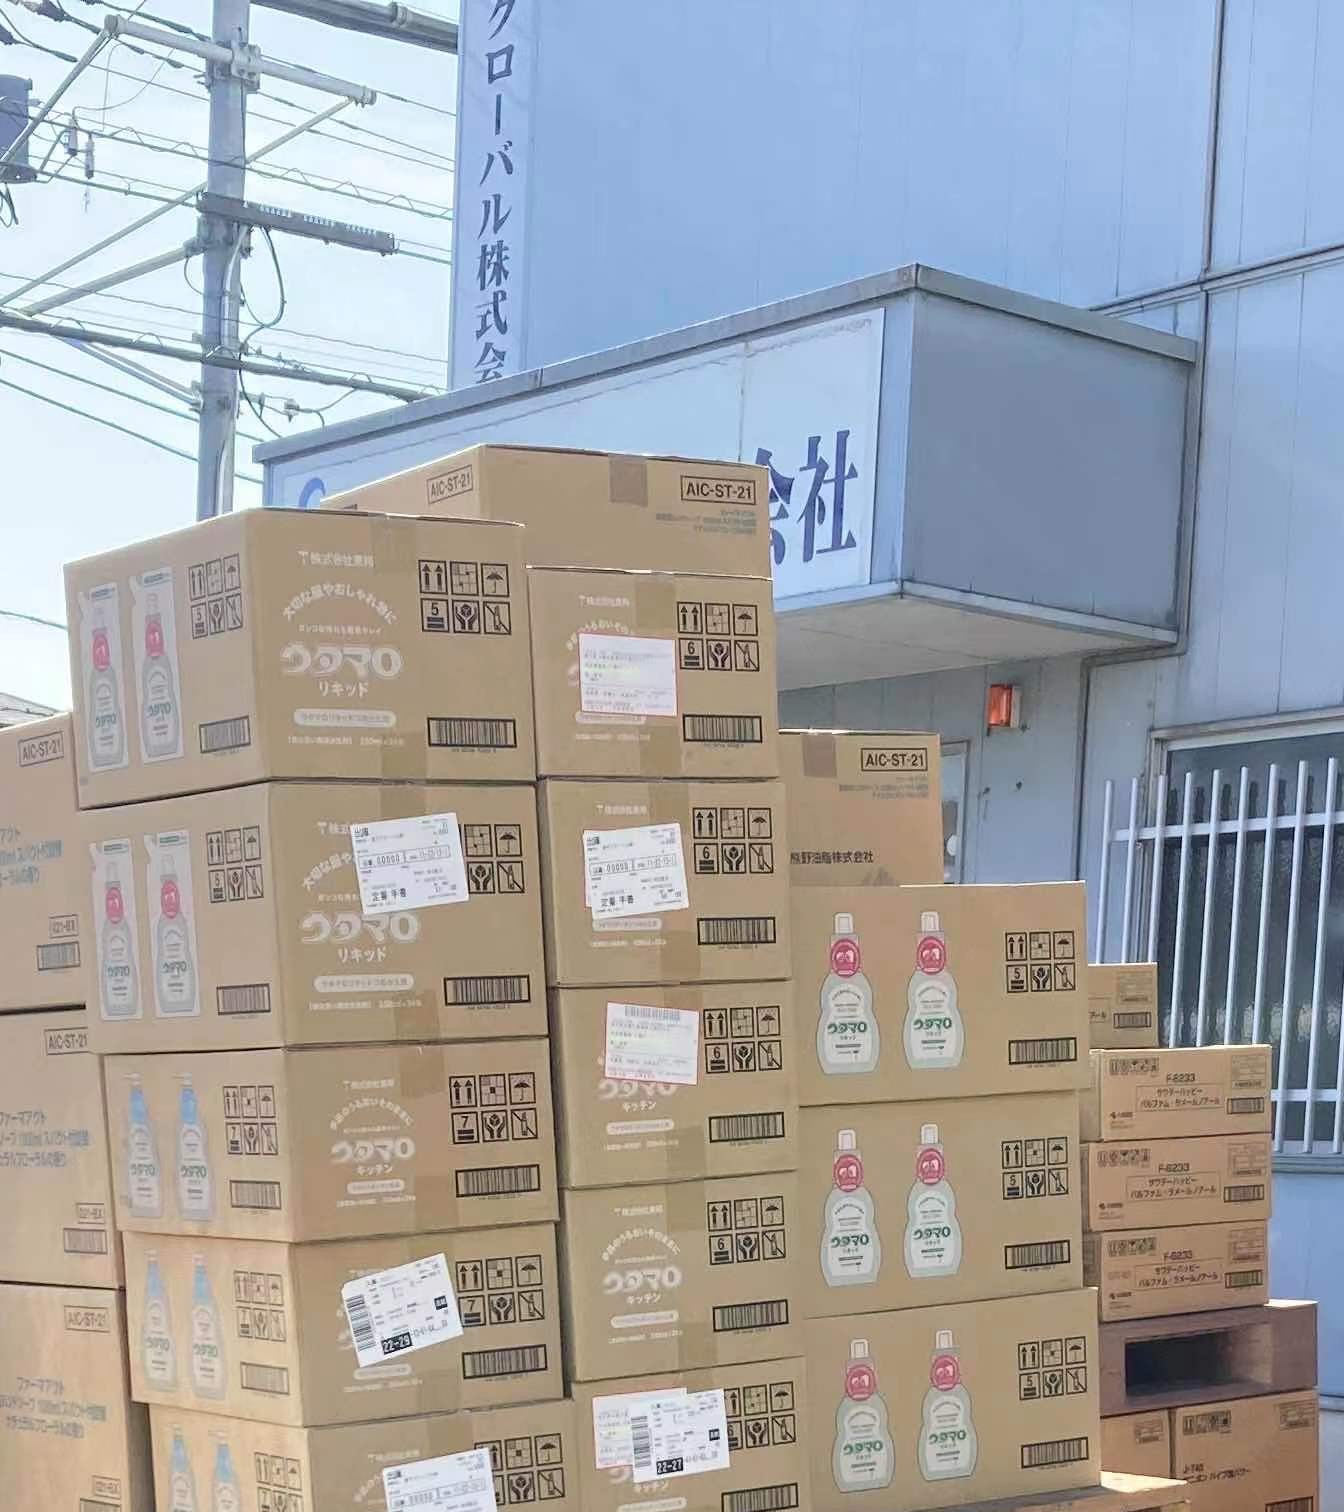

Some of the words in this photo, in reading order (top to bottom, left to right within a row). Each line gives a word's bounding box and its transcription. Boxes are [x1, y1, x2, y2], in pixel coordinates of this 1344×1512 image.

[686, 482, 752, 500] AIC-ST-21
[319, 681, 369, 698] リキッド
[865, 753, 925, 769] AIC-ST-21
[338, 946, 387, 963] リキッド
